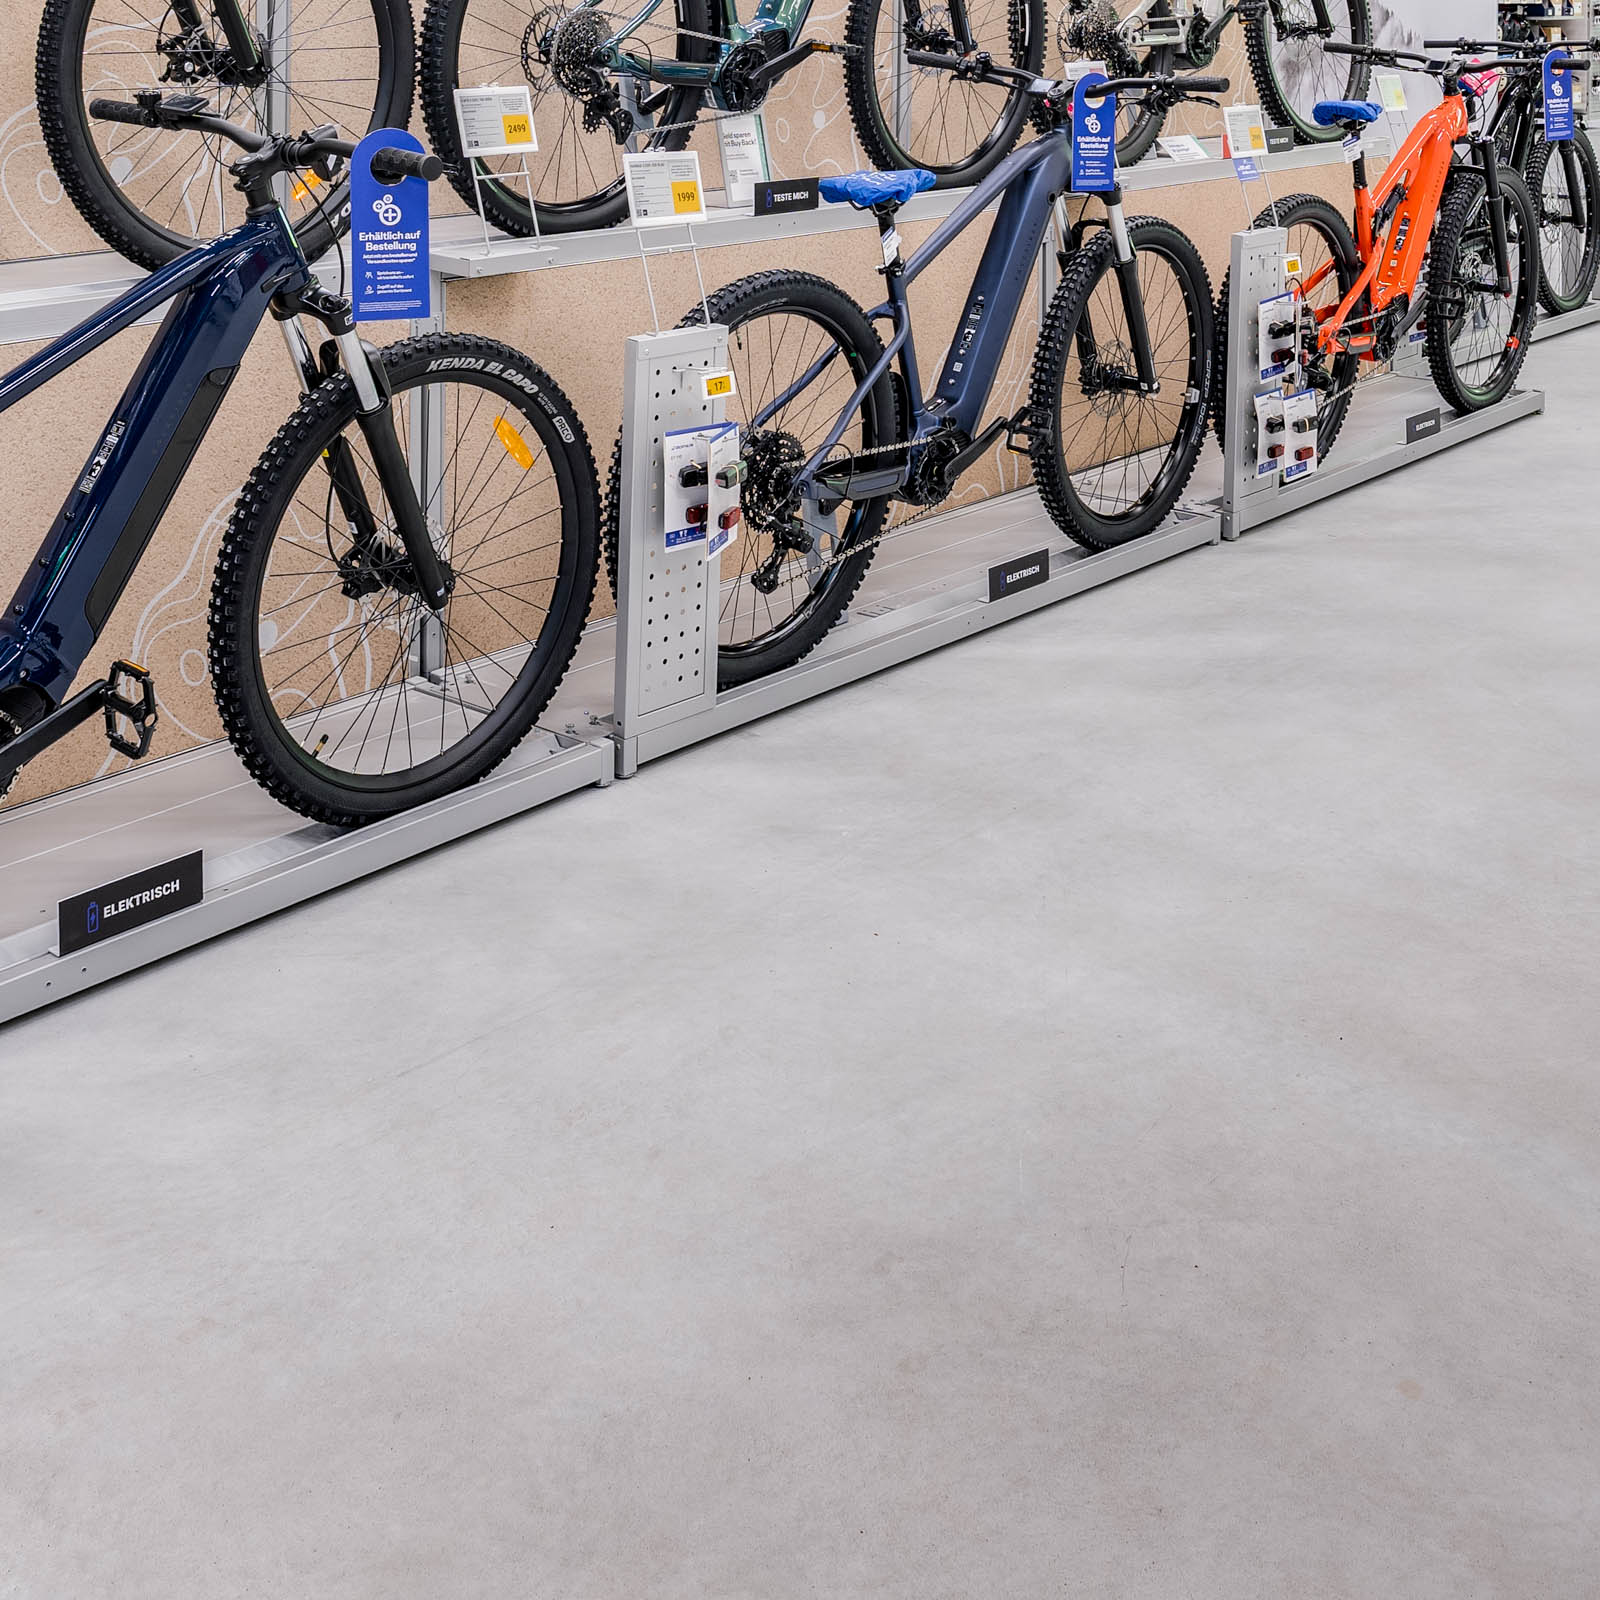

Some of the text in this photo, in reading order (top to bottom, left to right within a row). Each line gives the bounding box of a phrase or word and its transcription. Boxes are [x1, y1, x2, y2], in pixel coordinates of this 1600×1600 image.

[508, 124, 526, 134] 2499
[677, 192, 695, 202] 1999
[773, 191, 809, 203] TESTE MICH
[359, 230, 421, 242] Erhältlich auf
[365, 241, 417, 252] Bestellung
[426, 357, 539, 395] KENDA EL CAPO
[714, 382, 722, 391] 17
[1006, 564, 1040, 584] ELEKTRISCH
[103, 879, 180, 919] ELEKTRISCH
